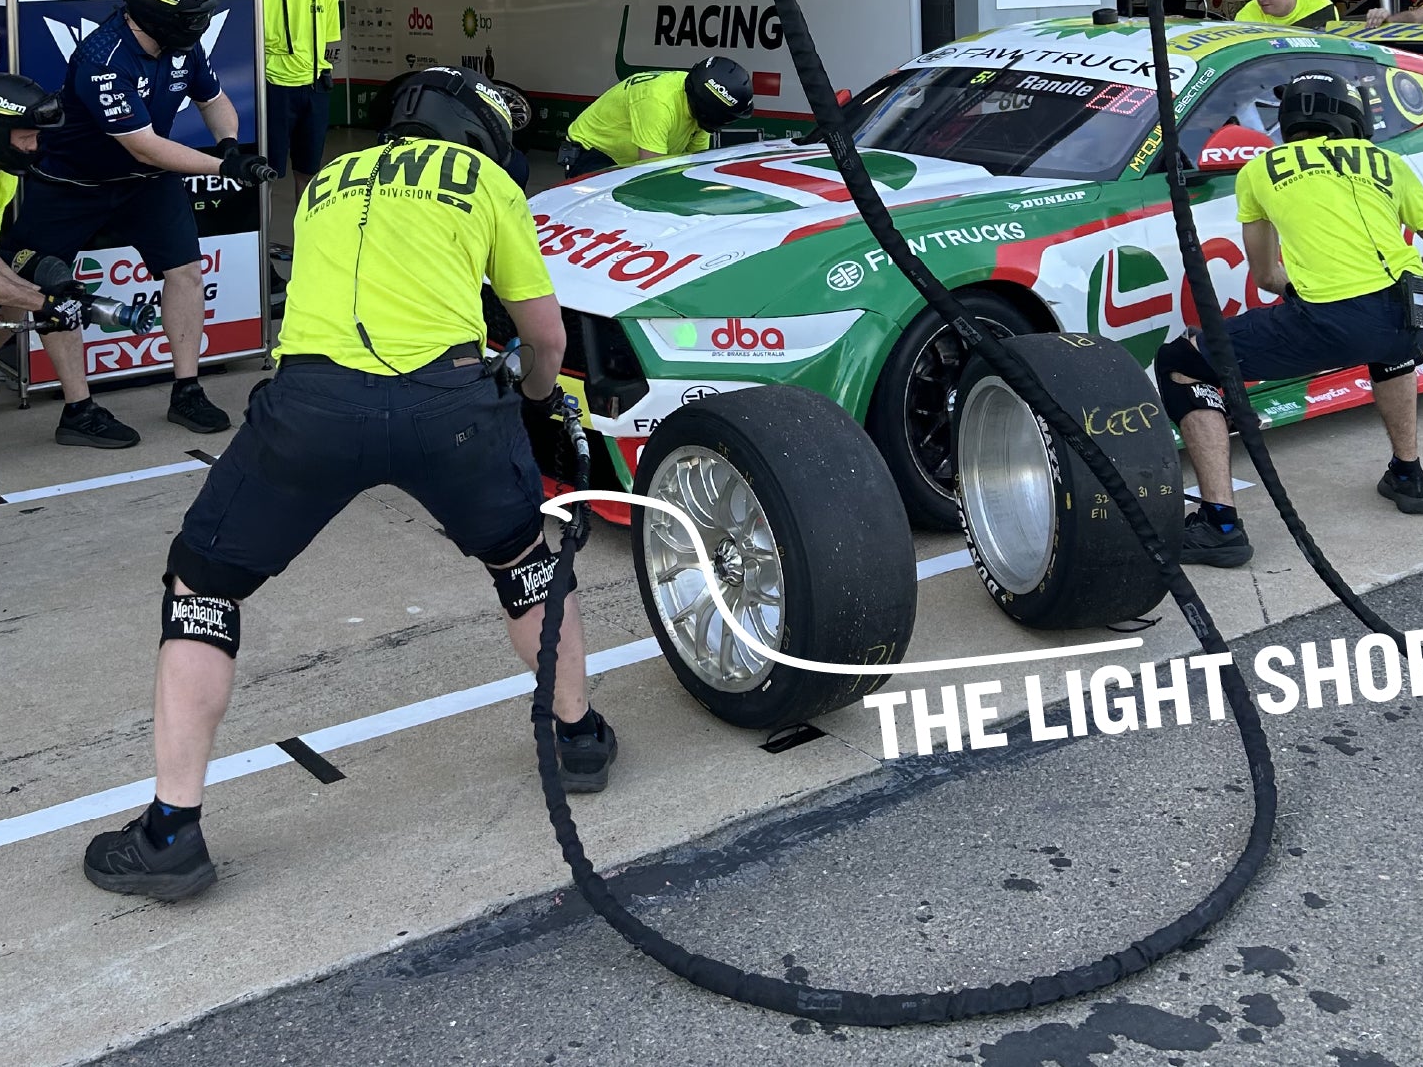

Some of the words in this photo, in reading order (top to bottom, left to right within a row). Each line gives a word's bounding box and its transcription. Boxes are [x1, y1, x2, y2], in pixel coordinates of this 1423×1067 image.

[408, 7, 434, 30] dba
[480, 14, 492, 32] bp
[654, 5, 784, 50] RACING
[955, 48, 1024, 61] FAW
[1286, 38, 1321, 49] RANDLE
[91, 72, 117, 82] RYCO
[1016, 75, 1095, 97] Randle
[113, 92, 125, 102] bp
[1174, 66, 1216, 114] electrical
[1201, 146, 1276, 163] RYCO
[1265, 145, 1394, 187] ELWD
[307, 144, 482, 212] ELWD
[1274, 175, 1304, 192] ELWOOD
[1307, 169, 1333, 177] WORK
[380, 188, 433, 201] DIVISION
[1020, 190, 1087, 209] DUNLOP
[928, 221, 1026, 251] TRUCKS
[711, 318, 785, 350] dba
[752, 350, 785, 358] AUSTRALIA
[1081, 402, 1159, 436] KEEP
[1095, 494, 1110, 505] 32
[1138, 486, 1148, 498] 31
[1160, 485, 1172, 496] 32
[171, 600, 227, 627] Mechanix
